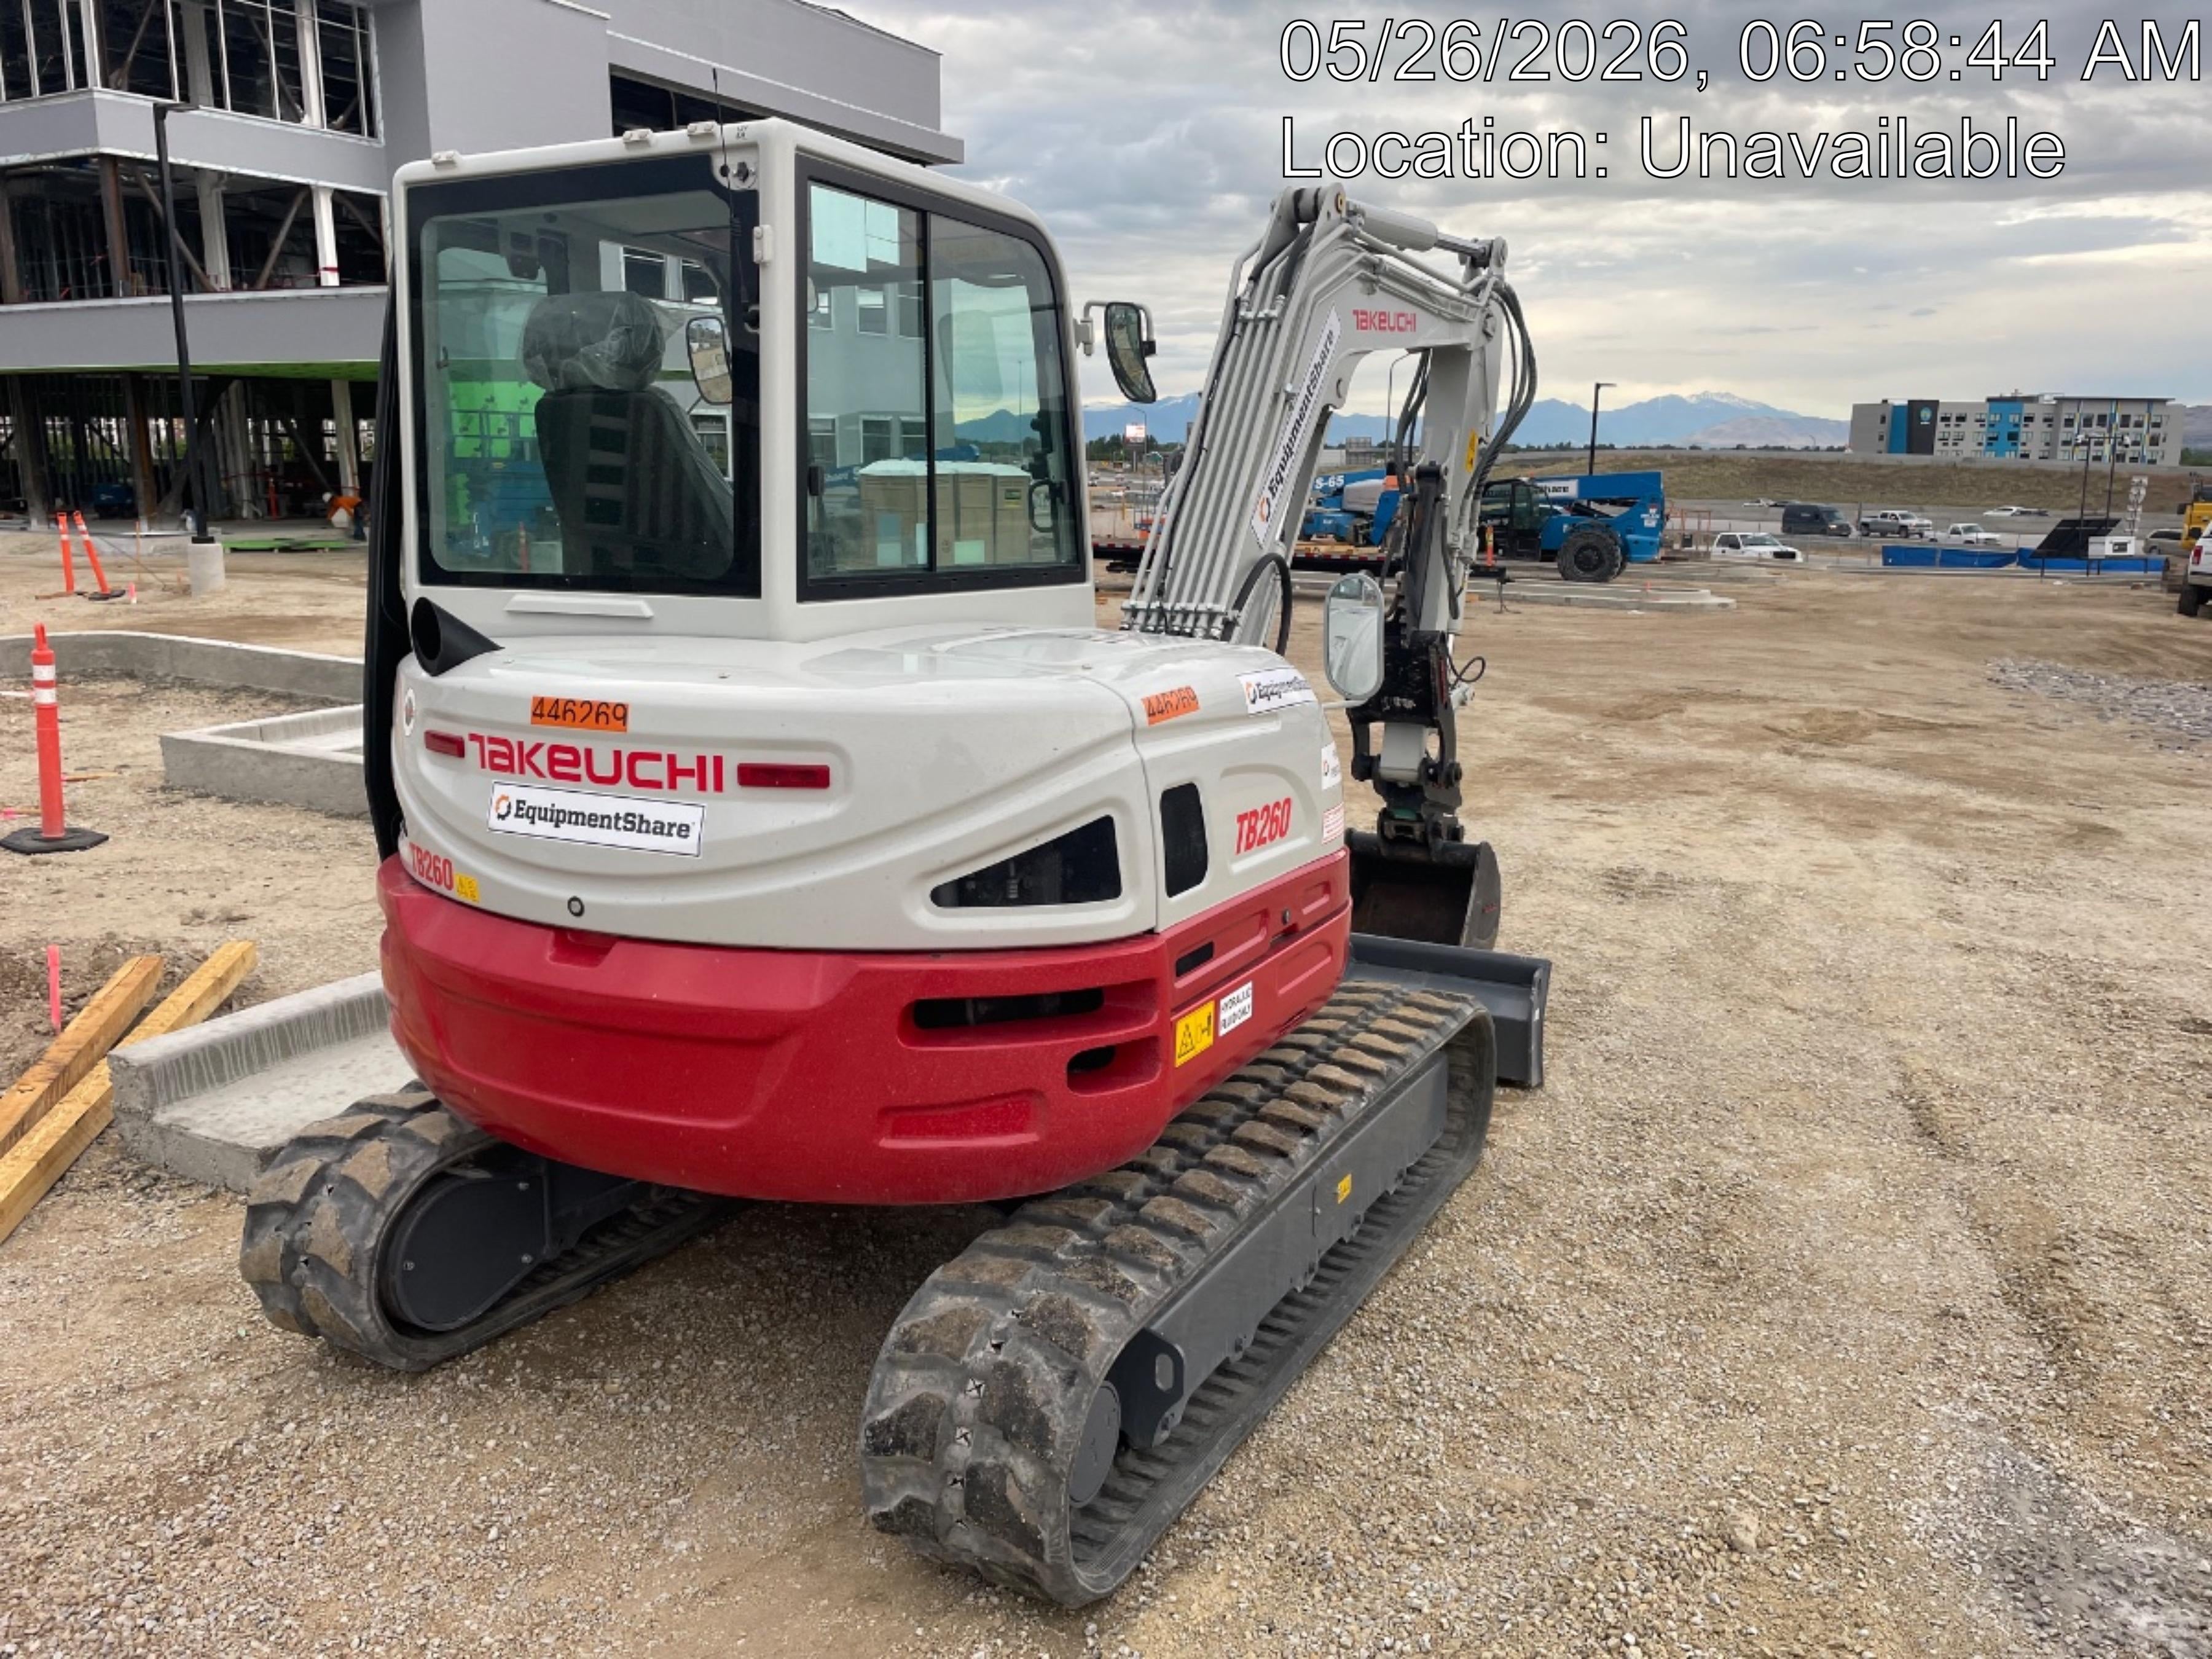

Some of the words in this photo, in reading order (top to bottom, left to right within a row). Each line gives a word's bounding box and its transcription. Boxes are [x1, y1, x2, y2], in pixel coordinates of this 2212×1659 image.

[1268, 329, 1335, 499] EquipmentShare
[1315, 475, 1344, 489] S-65
[531, 697, 627, 727] 446269
[514, 799, 691, 839] EquipmentShare
[1234, 798, 1292, 855] TB260
[409, 842, 453, 891] TB260
